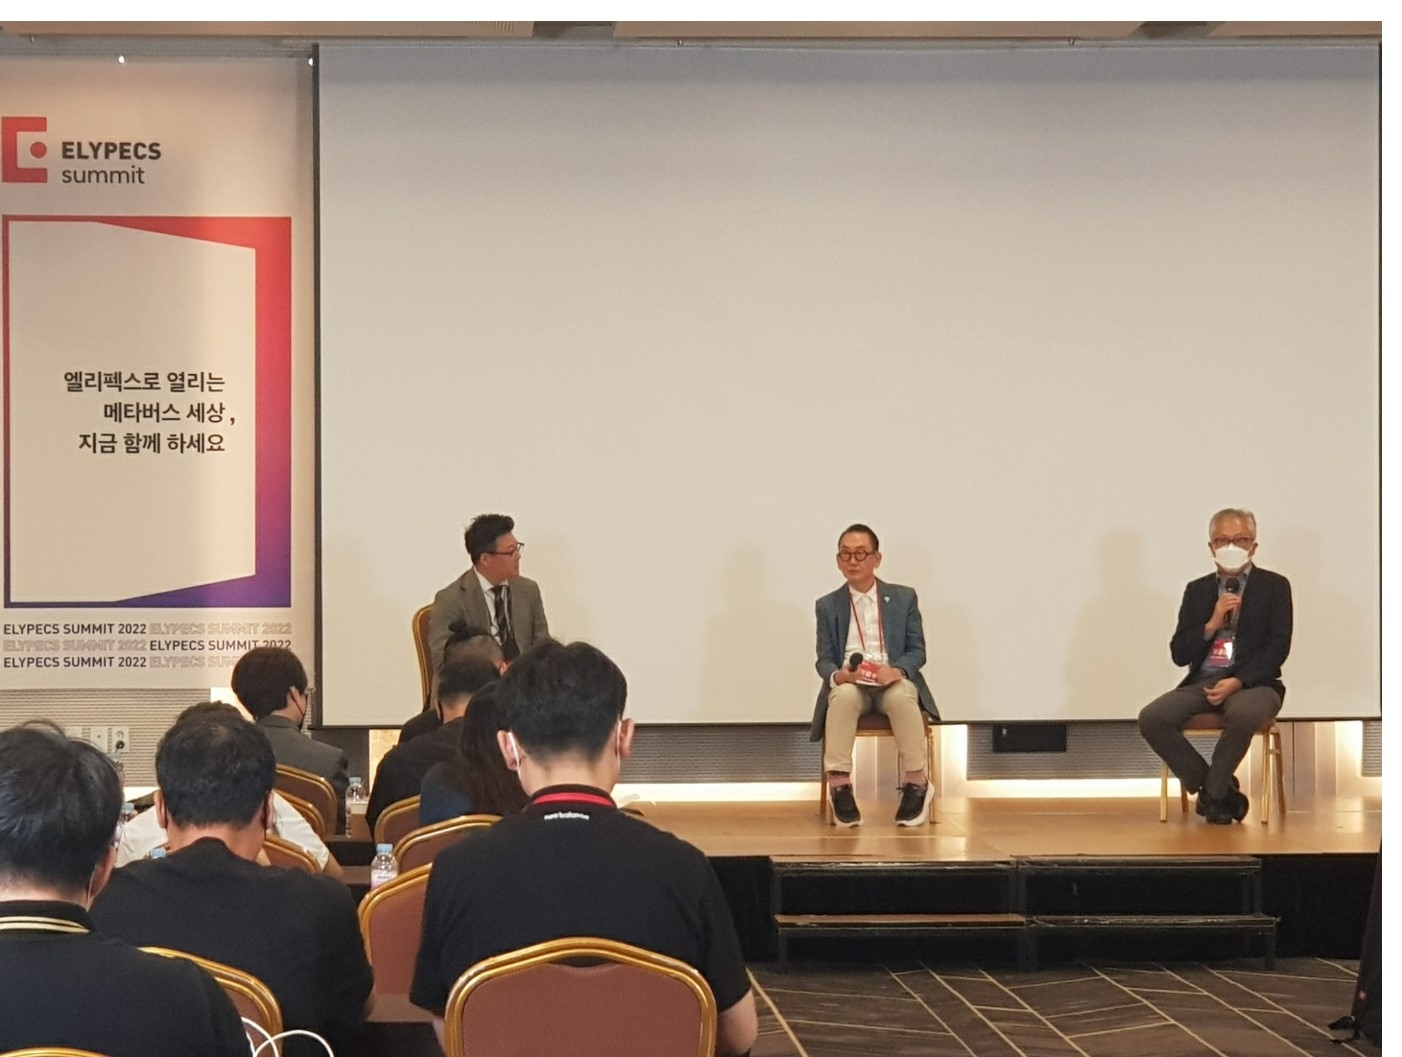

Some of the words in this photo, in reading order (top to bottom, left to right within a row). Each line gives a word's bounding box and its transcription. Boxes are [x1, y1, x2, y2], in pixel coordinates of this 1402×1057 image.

[61, 141, 162, 160] ELYPECS
[61, 165, 146, 185] summit
[64, 371, 161, 393] 엘리펙스로
[167, 371, 226, 393] 열리는
[104, 401, 181, 424] 메타버스
[78, 432, 118, 454] 지금
[123, 432, 161, 454] 함께
[166, 432, 226, 454] 하세요
[3, 623, 60, 635] ELYPECS
[63, 623, 115, 635] SUMMIT
[117, 623, 147, 634] 2022
[149, 639, 206, 651] ELYPECS
[208, 639, 259, 651] SUMMIT
[3, 656, 60, 668] ELYPECS
[63, 656, 115, 668] SUMMIT
[117, 656, 147, 668] 2022
